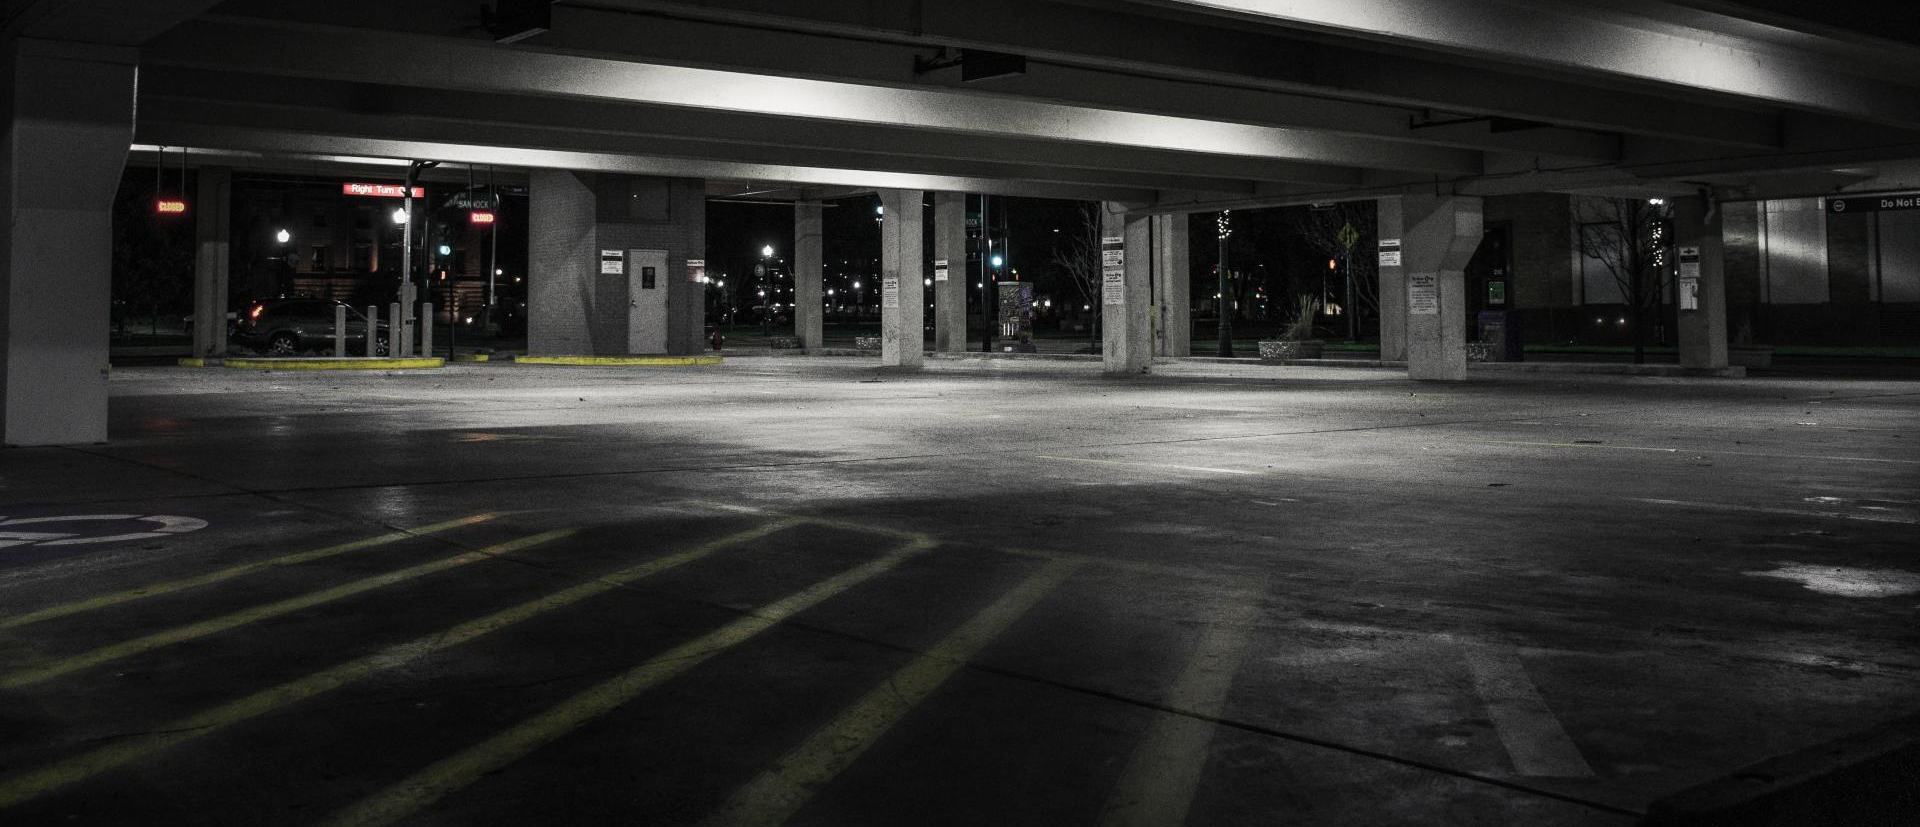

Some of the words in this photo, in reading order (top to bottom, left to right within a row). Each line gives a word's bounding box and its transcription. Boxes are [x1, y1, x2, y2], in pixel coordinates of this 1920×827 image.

[351, 184, 372, 195] Right
[376, 186, 394, 194] Turn
[397, 187, 416, 197] Oy
[1881, 199, 1894, 208] Do
[1896, 197, 1913, 207] Not
